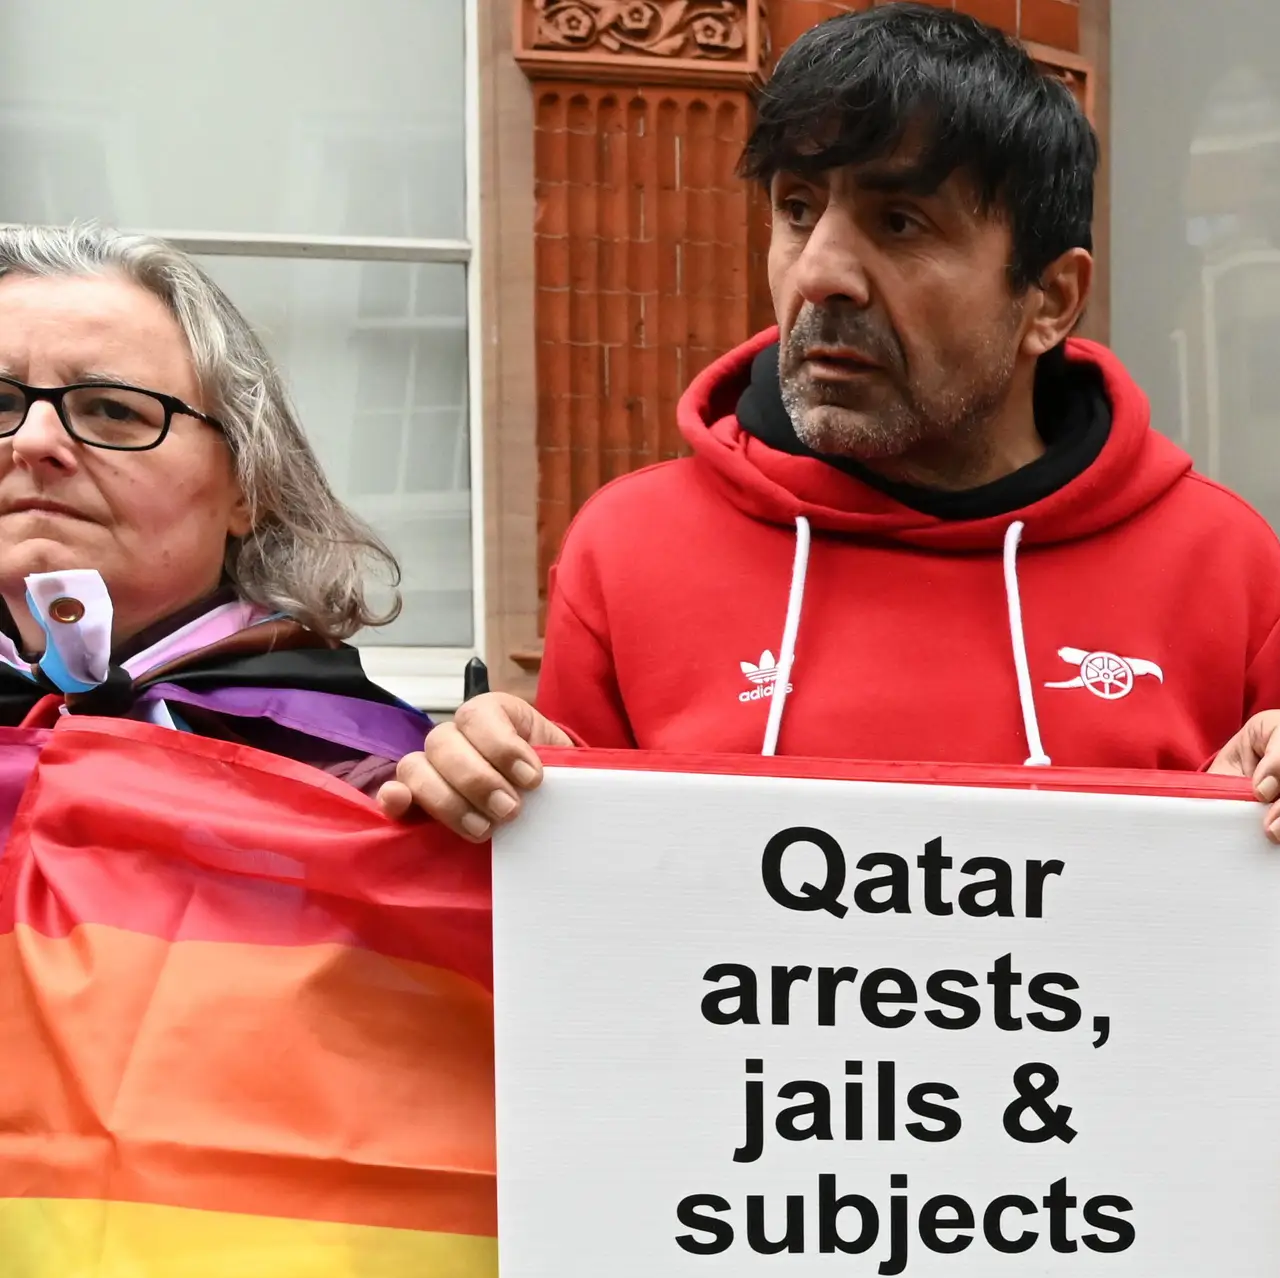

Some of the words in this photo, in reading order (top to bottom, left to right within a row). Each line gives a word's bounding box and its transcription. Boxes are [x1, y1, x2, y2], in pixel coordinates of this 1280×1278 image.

[738, 682, 794, 702] adids
[761, 826, 1066, 920] Qatar
[700, 952, 1111, 1050] arrests,
[732, 1058, 962, 1164] jails
[1002, 1061, 1079, 1145] &
[674, 1173, 1136, 1277] subjects
